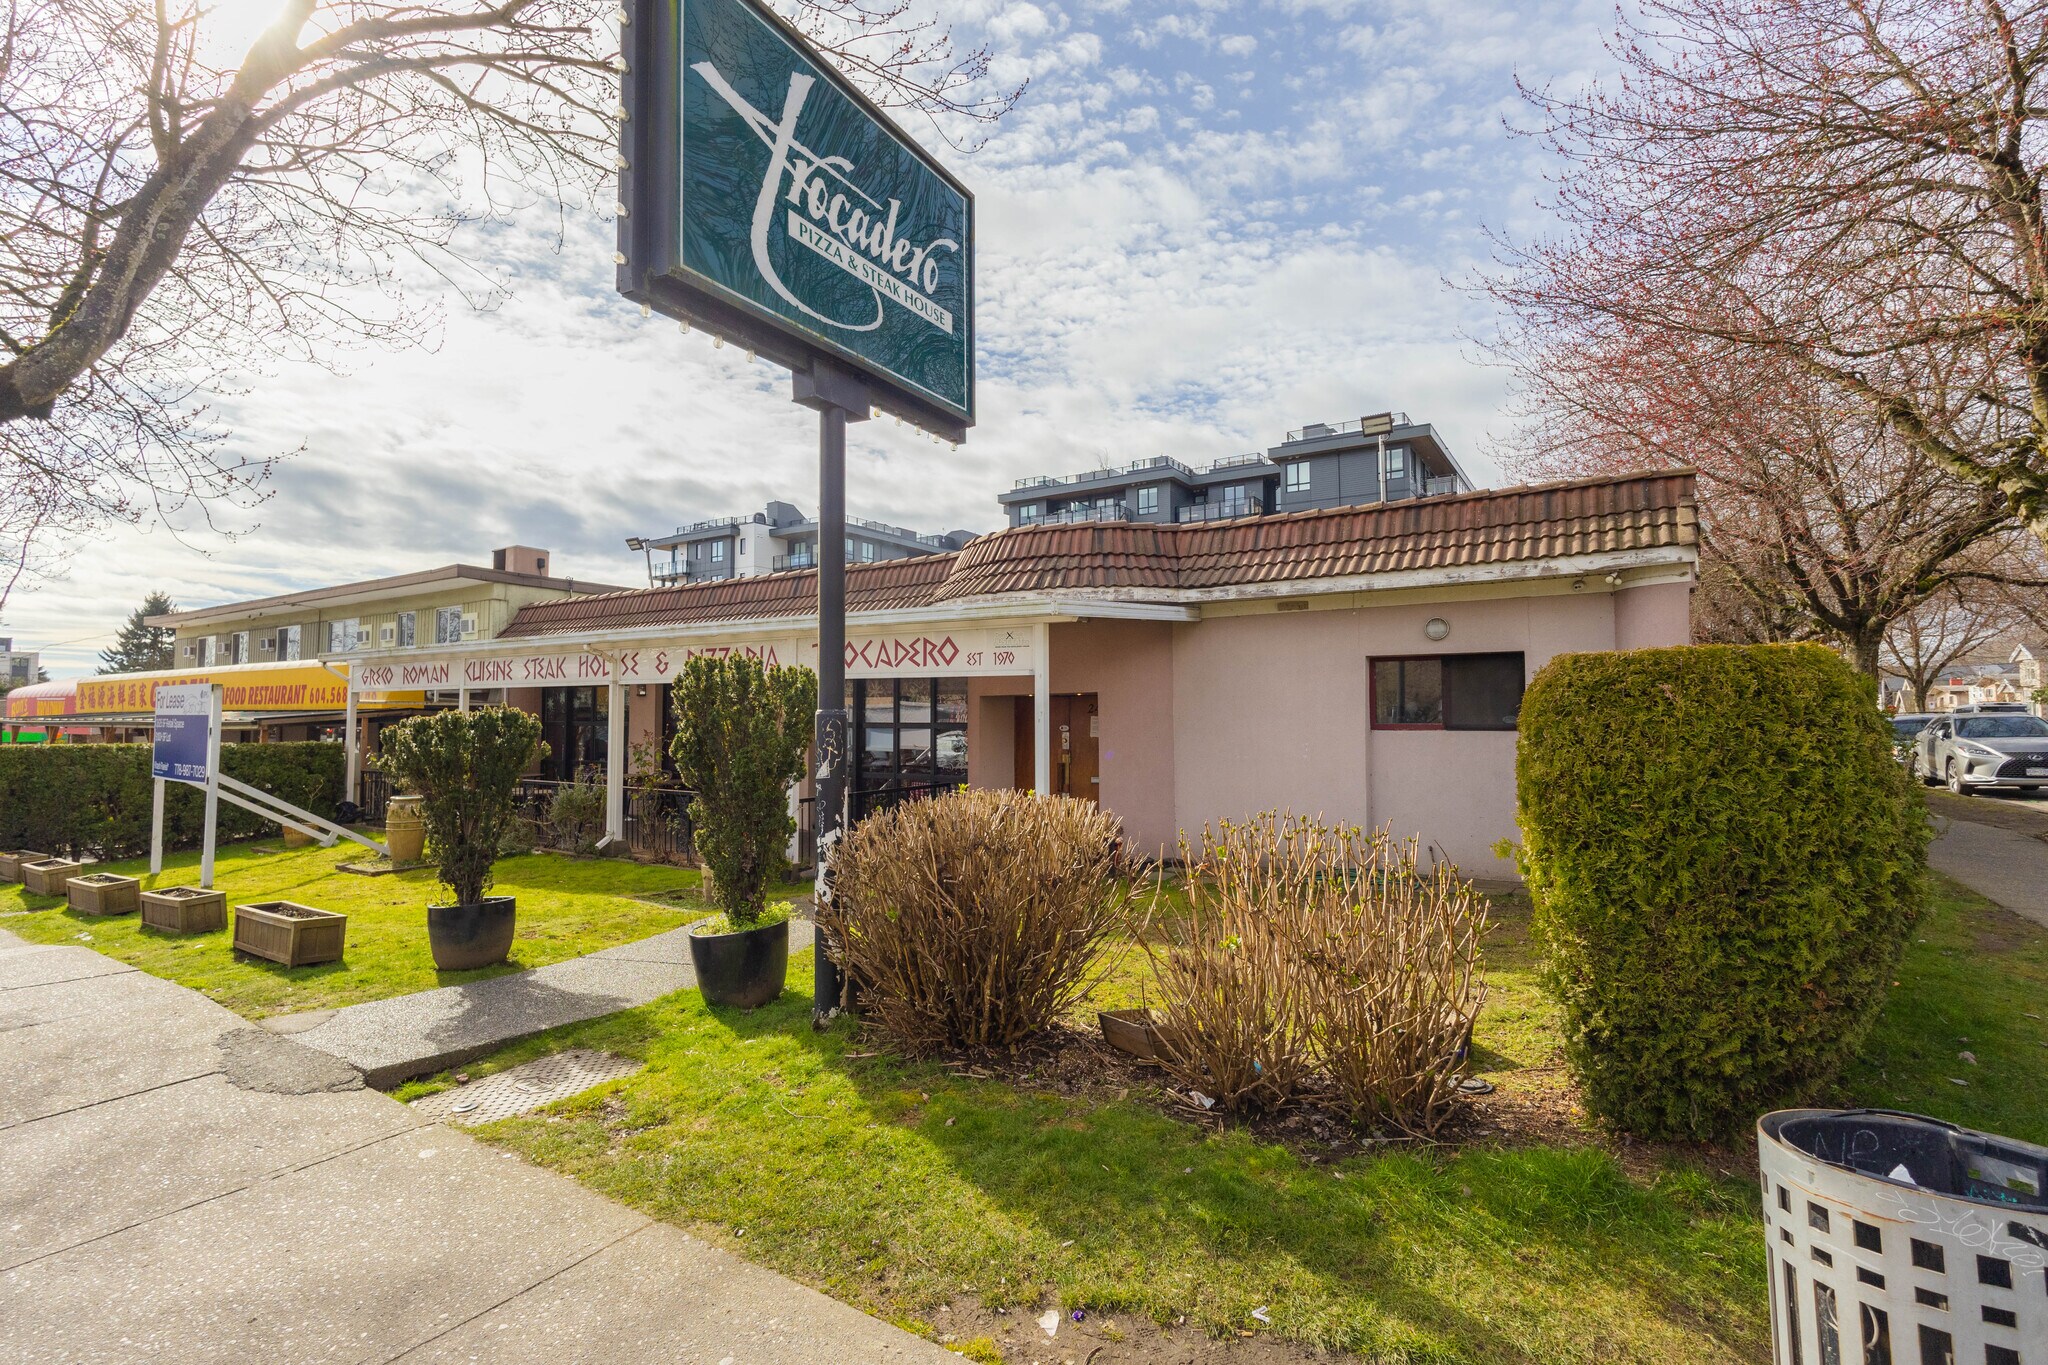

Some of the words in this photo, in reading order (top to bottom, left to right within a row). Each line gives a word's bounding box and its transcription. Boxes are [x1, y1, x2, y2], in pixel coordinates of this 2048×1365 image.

[799, 222, 844, 263] PIZZA
[847, 254, 858, 272] &
[861, 262, 901, 299] STEAK
[903, 289, 946, 326] HOUSE
[361, 666, 394, 686] GRECO
[402, 663, 450, 685] ROMAN
[465, 659, 514, 683] CUISINE
[523, 656, 567, 680] STEAK
[655, 650, 669, 675] &
[812, 635, 960, 669] OCADERO
[966, 651, 984, 666] EST
[992, 651, 1015, 666] 1970
[157, 691, 165, 709] For
[166, 690, 185, 709] Lease
[247, 684, 308, 706] RESTAURANT
